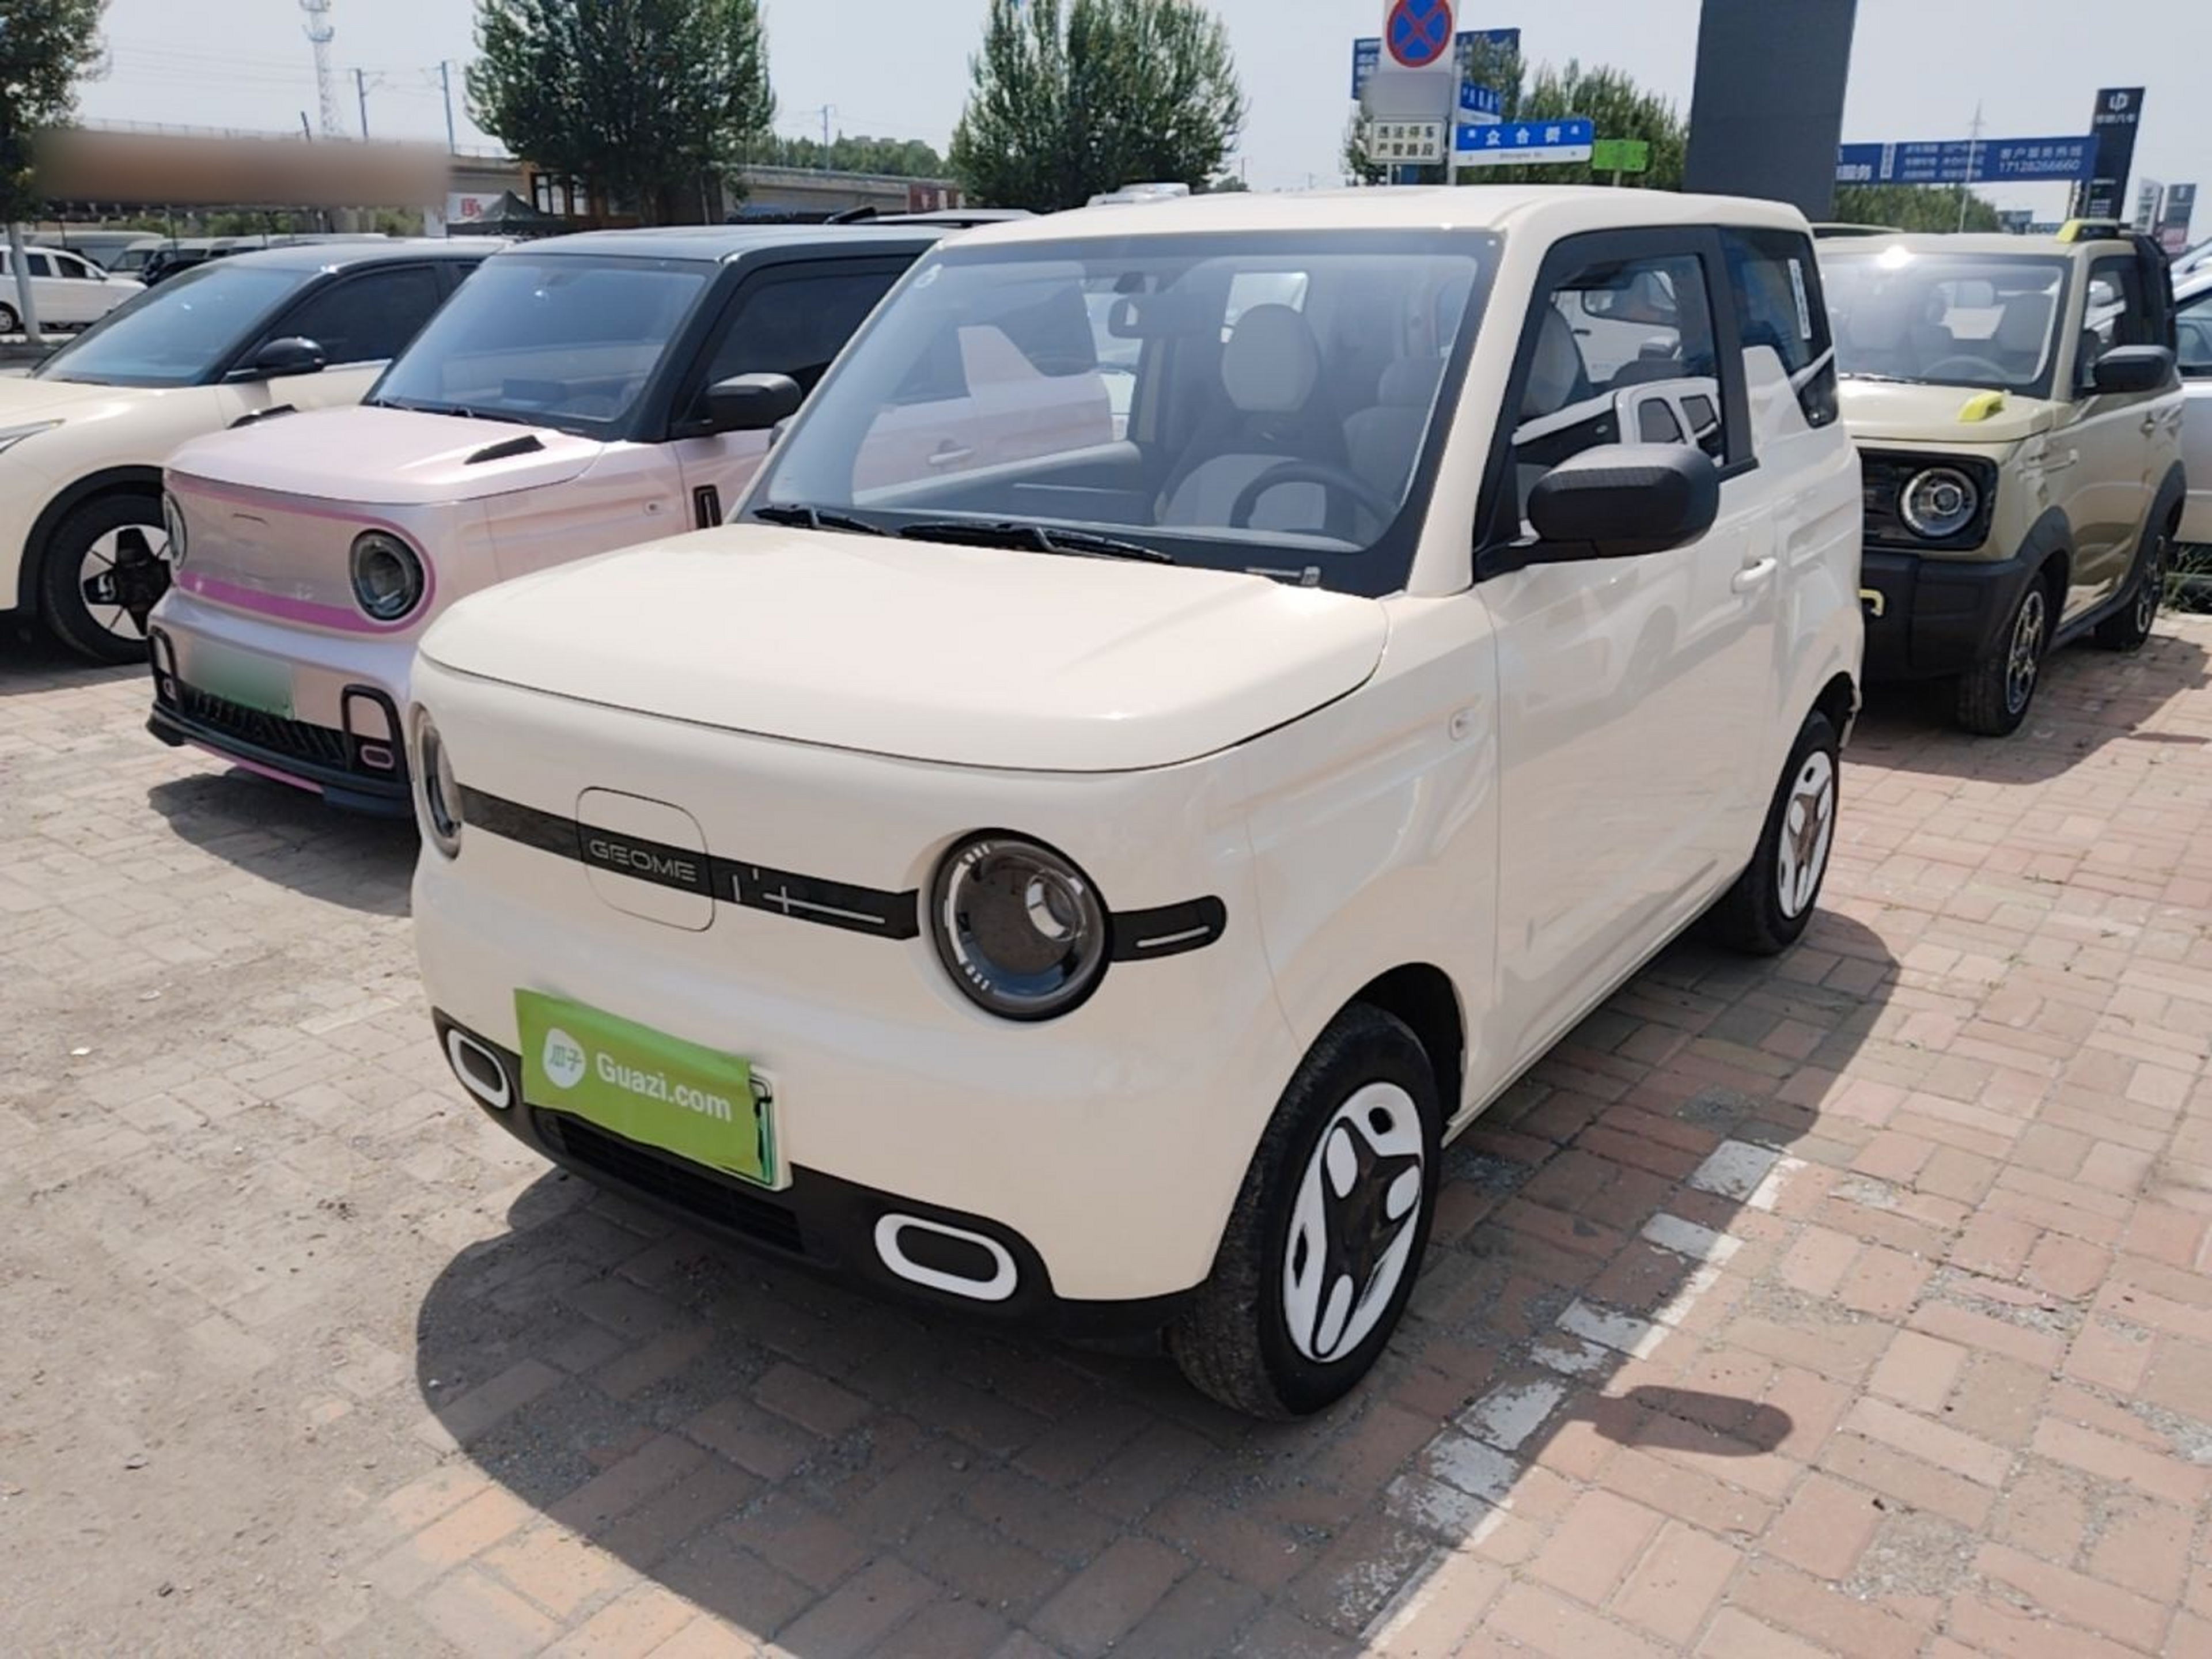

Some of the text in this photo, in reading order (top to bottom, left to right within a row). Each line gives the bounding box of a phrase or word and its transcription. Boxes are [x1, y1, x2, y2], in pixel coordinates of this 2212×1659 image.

[1376, 142, 1435, 157] 严管路段
[589, 839, 698, 883] GEOME
[549, 1043, 584, 1073] 瓜子
[596, 1051, 732, 1122] Guazi.com
